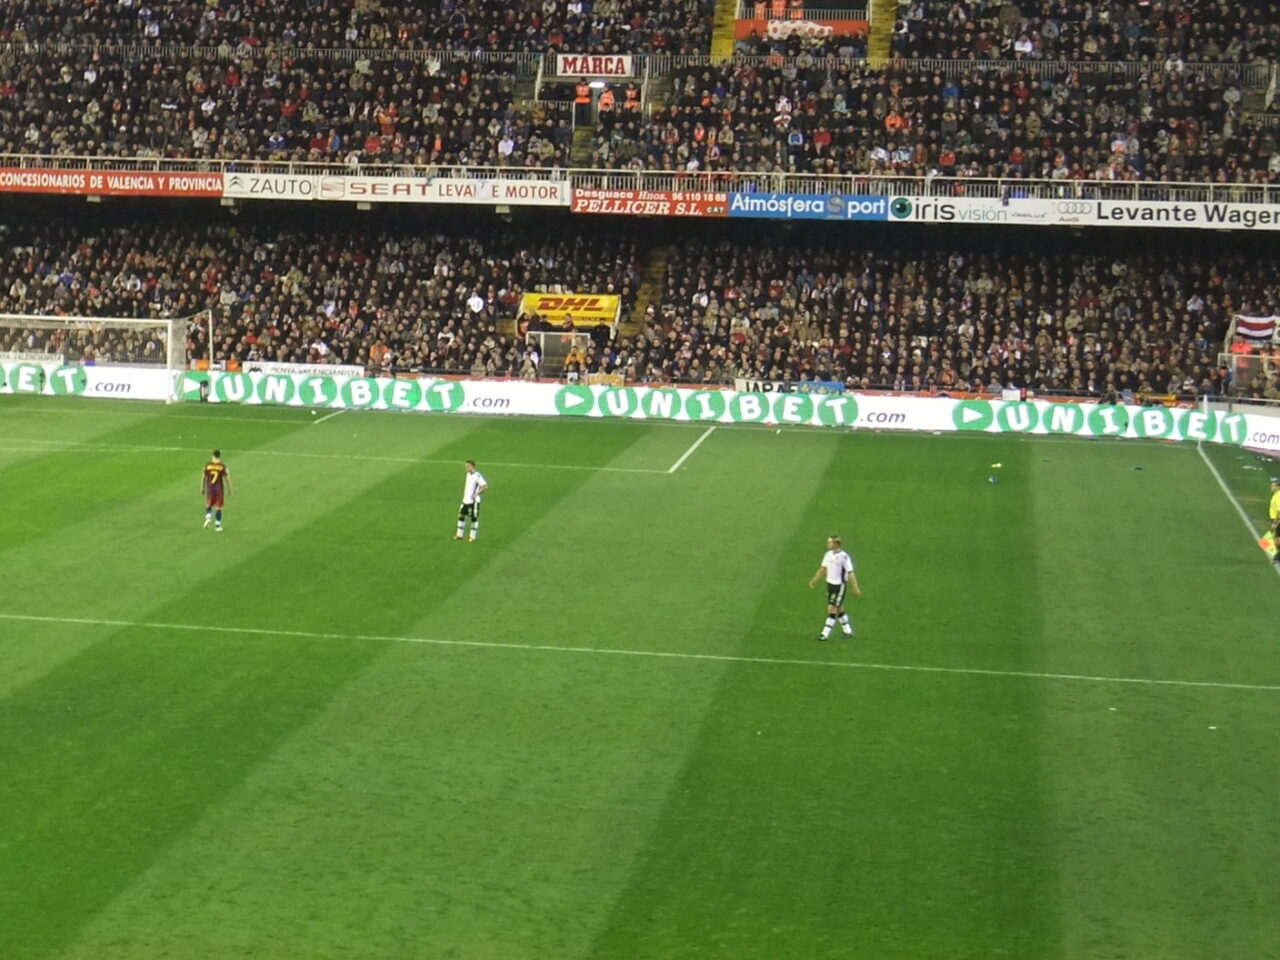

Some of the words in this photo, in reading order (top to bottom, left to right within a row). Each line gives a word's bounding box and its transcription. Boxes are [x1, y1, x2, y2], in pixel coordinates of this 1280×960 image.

[561, 56, 626, 75] MARCA
[0, 172, 85, 188] CONCESIONARIOS
[90, 175, 103, 188] DE
[107, 176, 154, 190] VALENCIA
[157, 177, 165, 189] Y
[169, 177, 223, 191] PROVINCIA
[249, 178, 312, 195] ZAUTO
[349, 182, 433, 196] SEAT
[438, 183, 499, 198] LEVAE
[505, 185, 558, 199] MOTOR
[575, 189, 634, 200] Desguace
[672, 193, 683, 201] 96
[685, 193, 701, 201] 110
[574, 199, 670, 215] PELLICER
[675, 203, 703, 216] S.L.
[730, 193, 824, 218] Atmósfera
[915, 197, 956, 221] iris
[959, 205, 1008, 222] visión
[1096, 202, 1197, 222] Levante
[537, 297, 605, 311] DHL
[223, 375, 457, 413] UNIBET
[607, 389, 848, 424] UNIBET
[1005, 404, 1242, 443] UNIBET
[210, 470, 218, 484] 7
